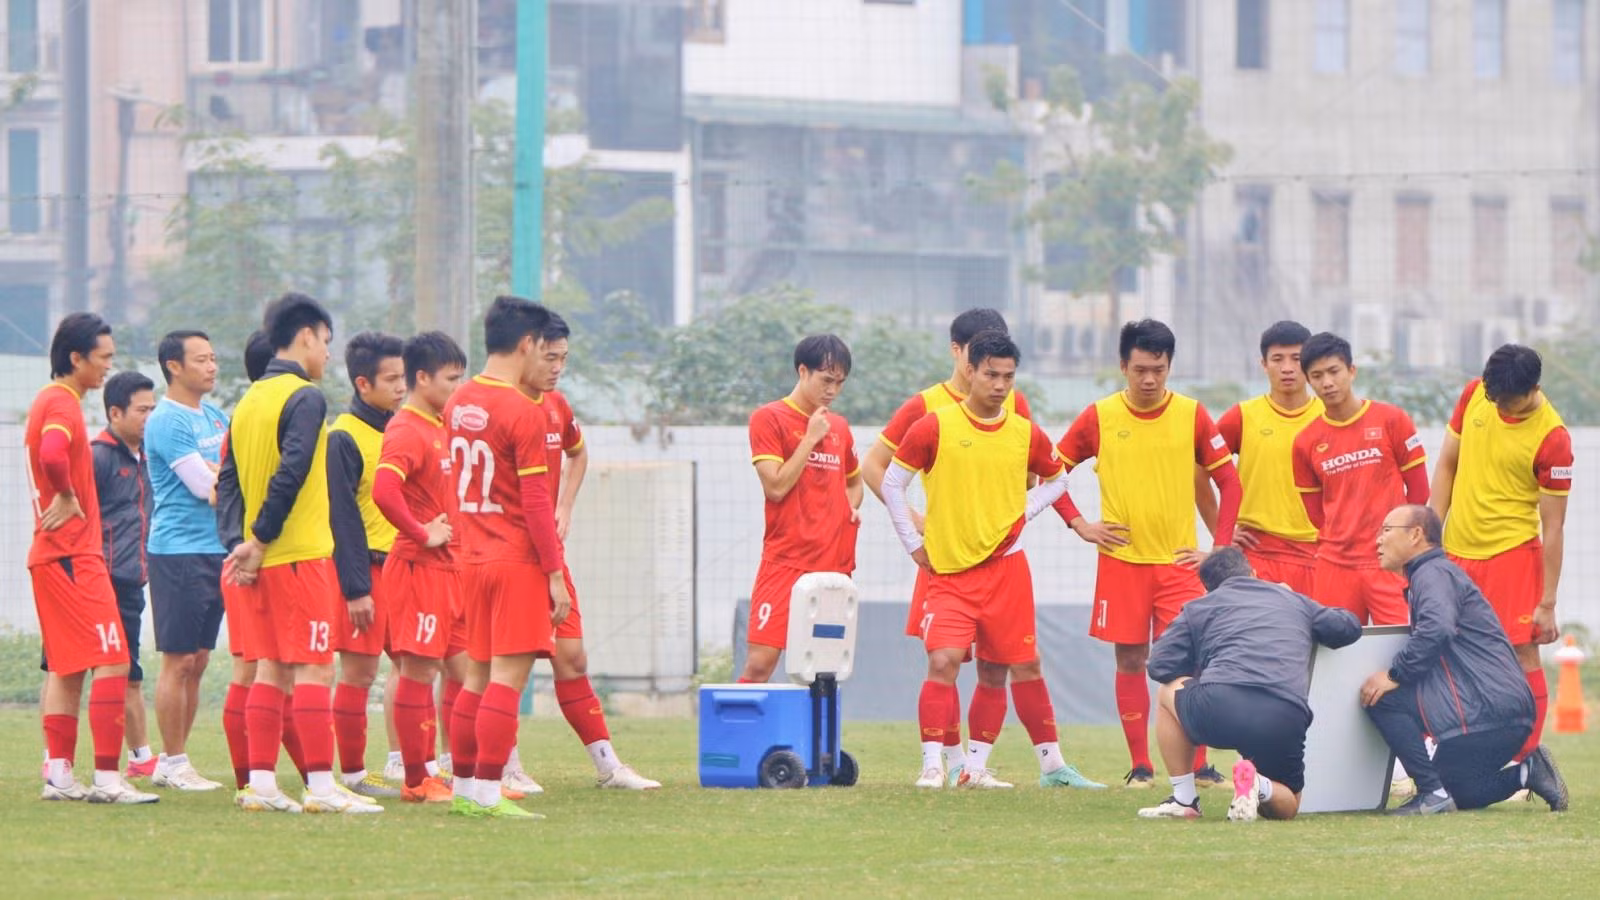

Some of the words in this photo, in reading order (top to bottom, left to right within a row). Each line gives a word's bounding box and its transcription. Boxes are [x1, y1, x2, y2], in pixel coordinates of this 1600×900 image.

[807, 451, 841, 465] ONDA
[1320, 447, 1384, 471] HONDA
[451, 436, 504, 513] 22
[416, 612, 437, 644] 19
[757, 602, 772, 630] 9
[95, 621, 121, 653] 14
[309, 620, 330, 652] 13
